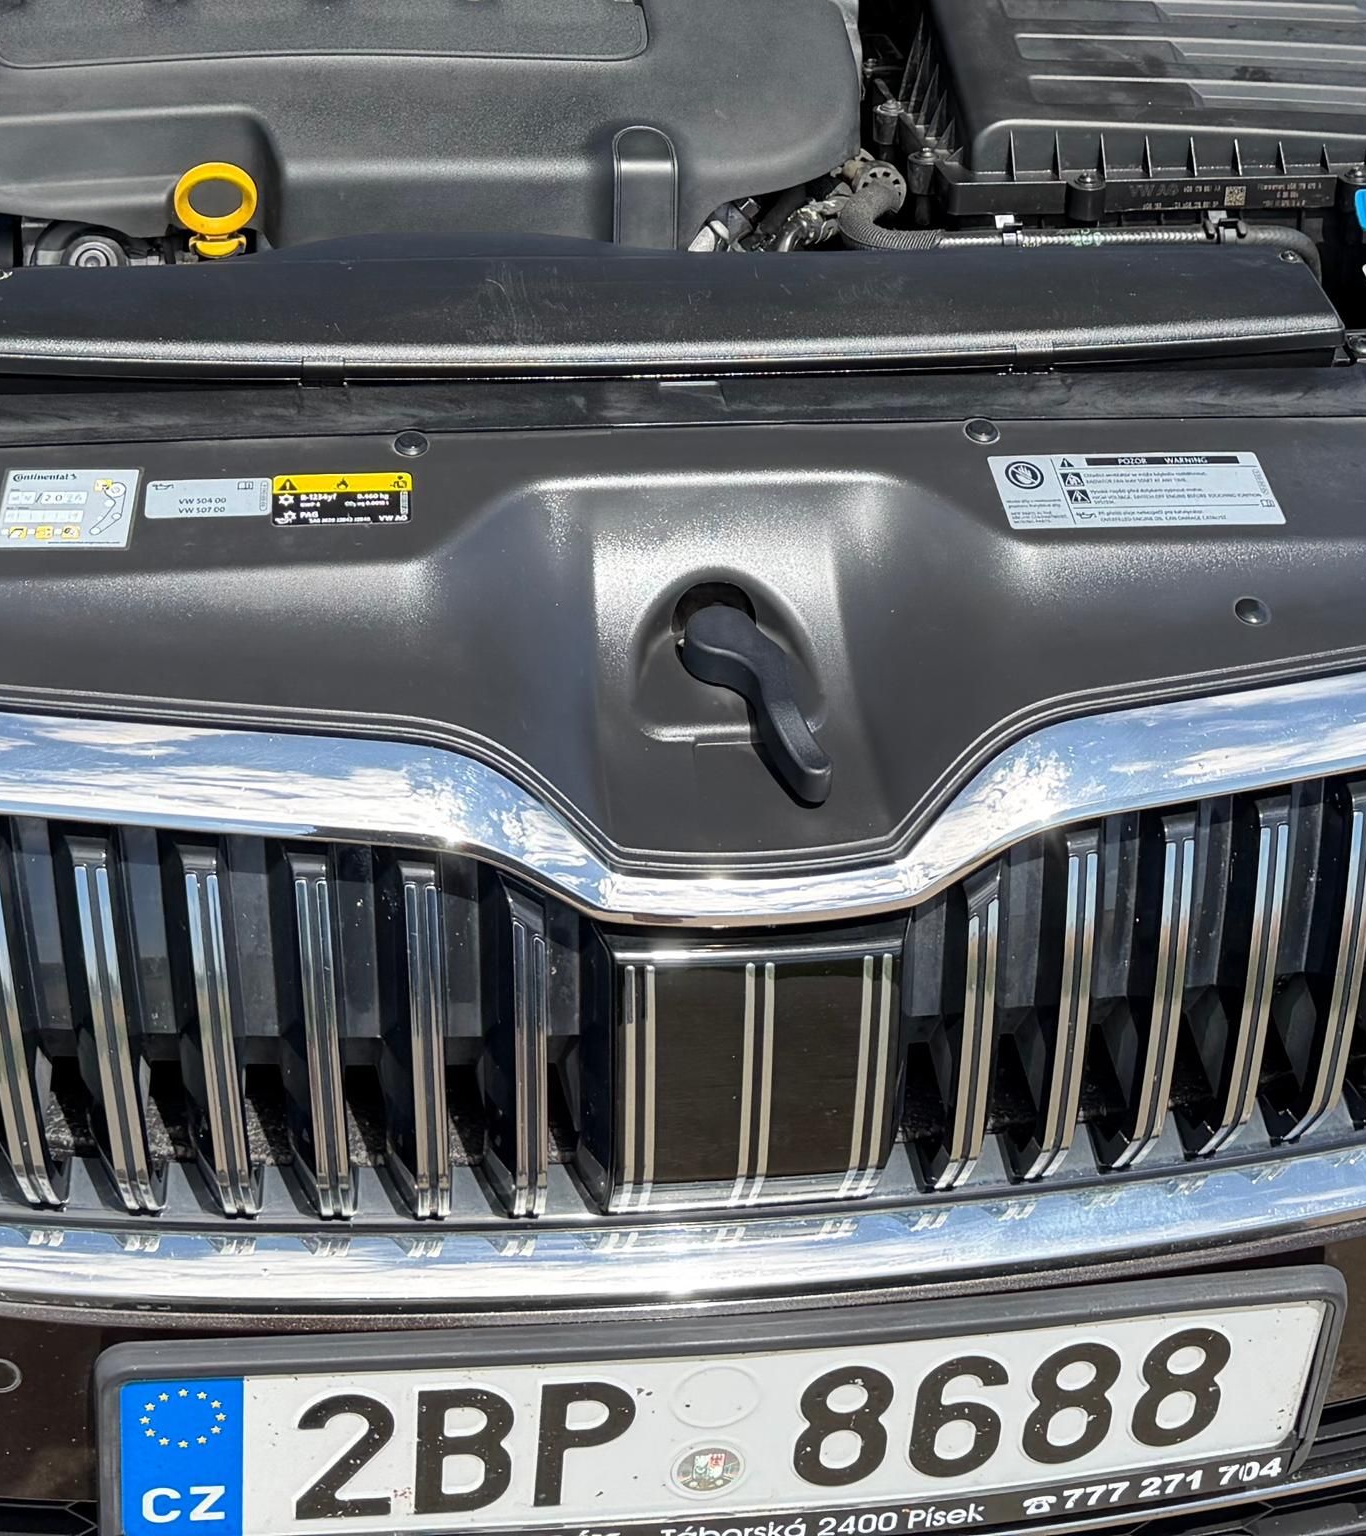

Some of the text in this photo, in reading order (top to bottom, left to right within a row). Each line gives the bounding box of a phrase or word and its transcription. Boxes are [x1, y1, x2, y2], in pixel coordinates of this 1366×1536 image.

[1117, 456, 1208, 465] POZOR WARNING
[12, 473, 69, 482] Continental
[196, 497, 213, 505] 504
[299, 511, 319, 519] PAG
[295, 1327, 1232, 1520] 2BP 8688
[816, 1511, 898, 1536] 2400
[907, 1503, 985, 1529] Písek
[1062, 1481, 1130, 1509] 777
[1138, 1469, 1203, 1499] 271
[1218, 1456, 1282, 1487] 704
[141, 1485, 226, 1522] CZ
